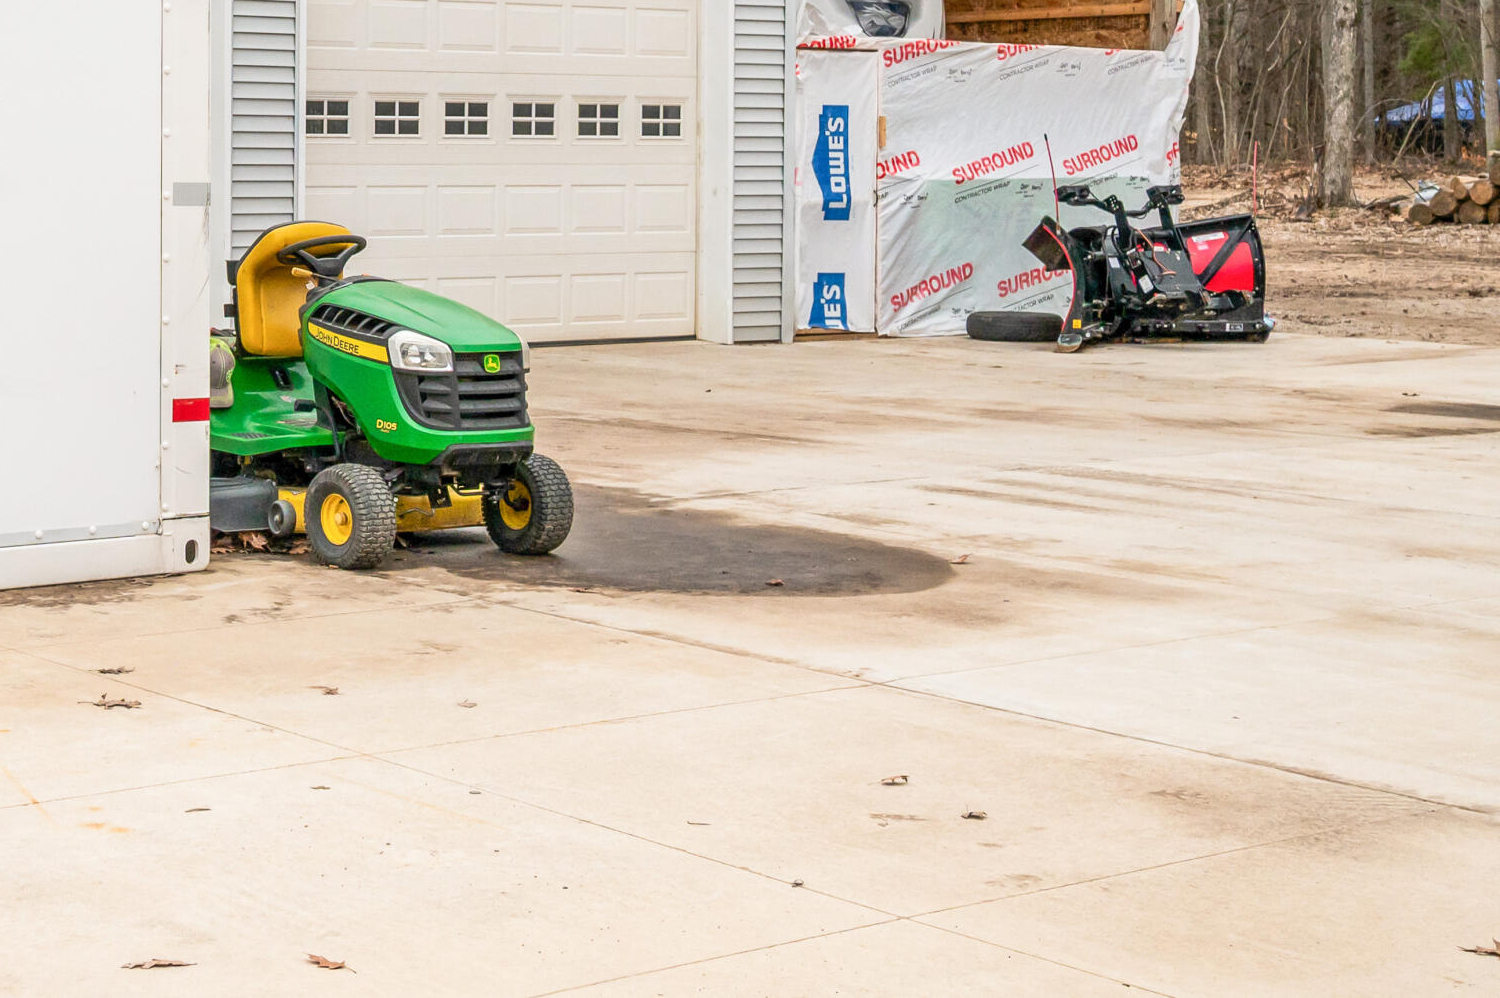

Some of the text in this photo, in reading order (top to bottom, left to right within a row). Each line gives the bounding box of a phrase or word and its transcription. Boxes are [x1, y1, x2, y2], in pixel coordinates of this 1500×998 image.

[825, 117, 847, 209] LOWE'S
[952, 141, 1034, 185] SURROUND
[1062, 134, 1138, 176] SURROUND
[954, 185, 993, 204] CONTRACTOR
[993, 180, 1011, 192] WRAP
[890, 262, 974, 313] SURROUND
[315, 327, 360, 354] JOHN DEERE
[376, 418, 397, 430] D105
